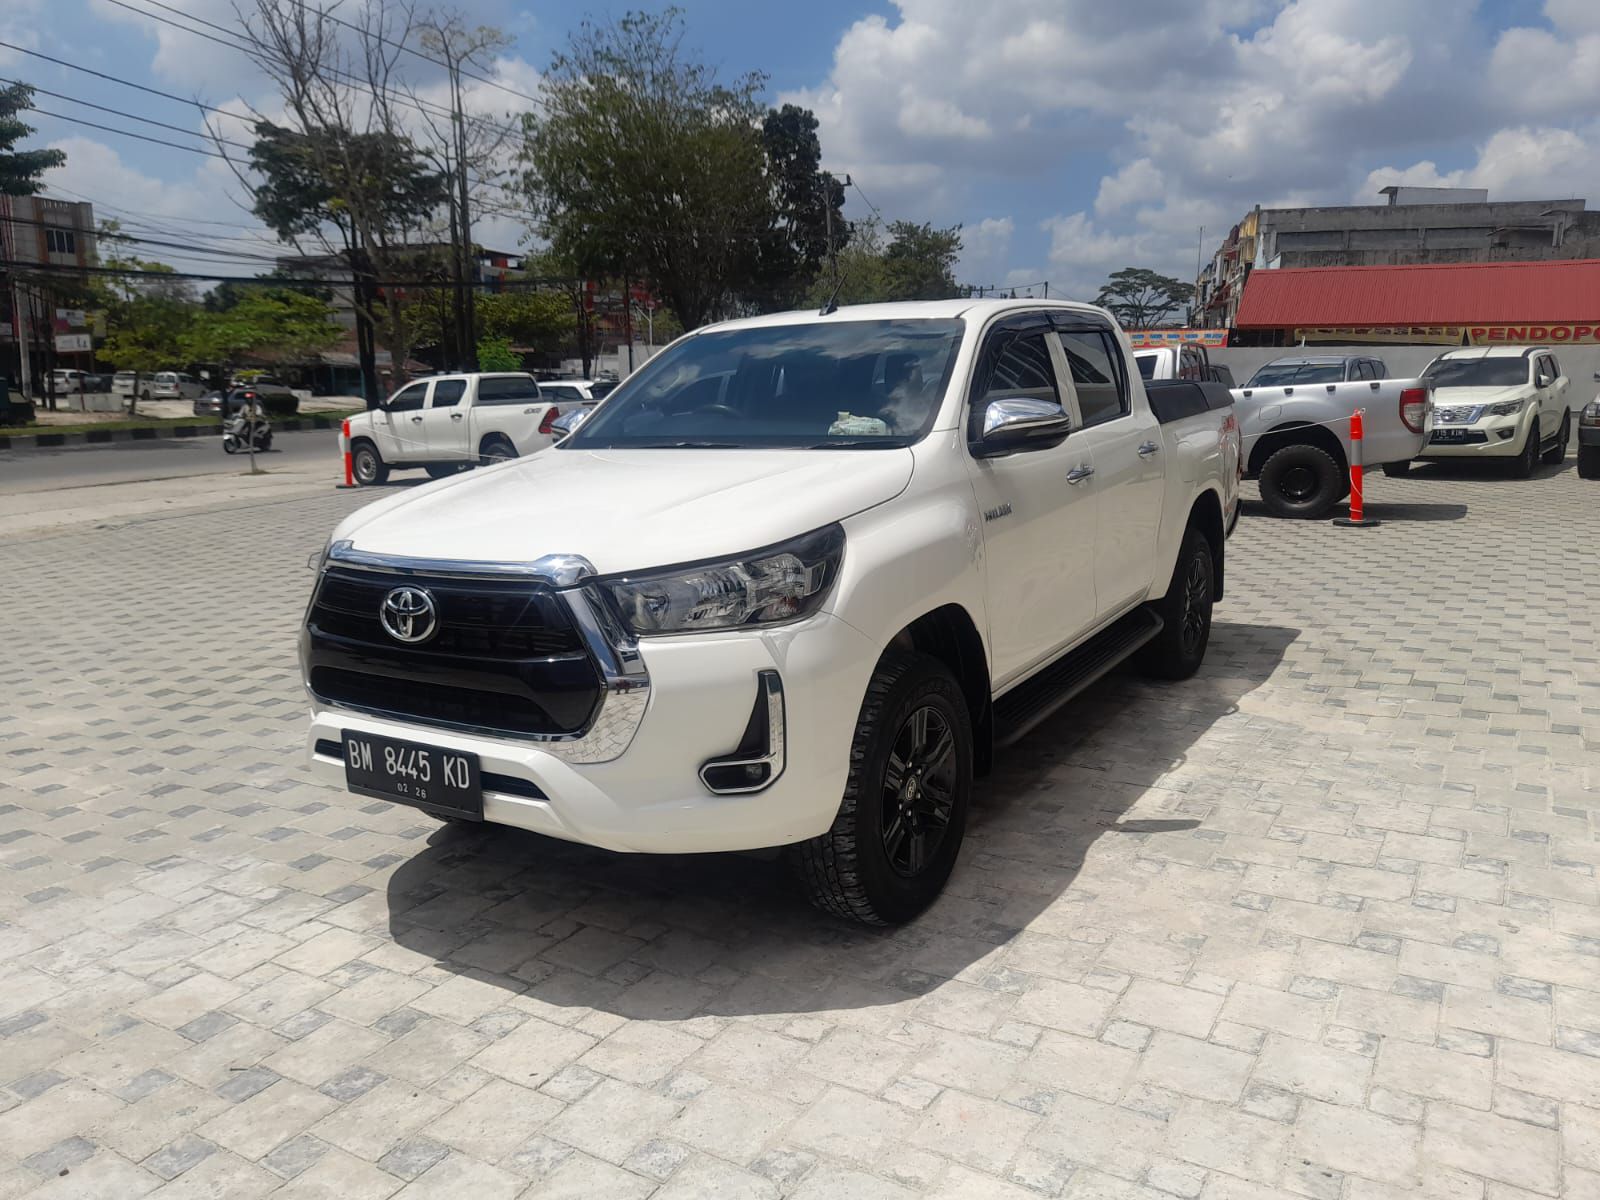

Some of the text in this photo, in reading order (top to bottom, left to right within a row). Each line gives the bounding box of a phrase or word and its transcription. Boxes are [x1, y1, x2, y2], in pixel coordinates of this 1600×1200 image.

[1471, 326, 1600, 341] PENDOP
[348, 739, 470, 789] BM 8445 KD
[397, 783, 427, 799] 02 26
